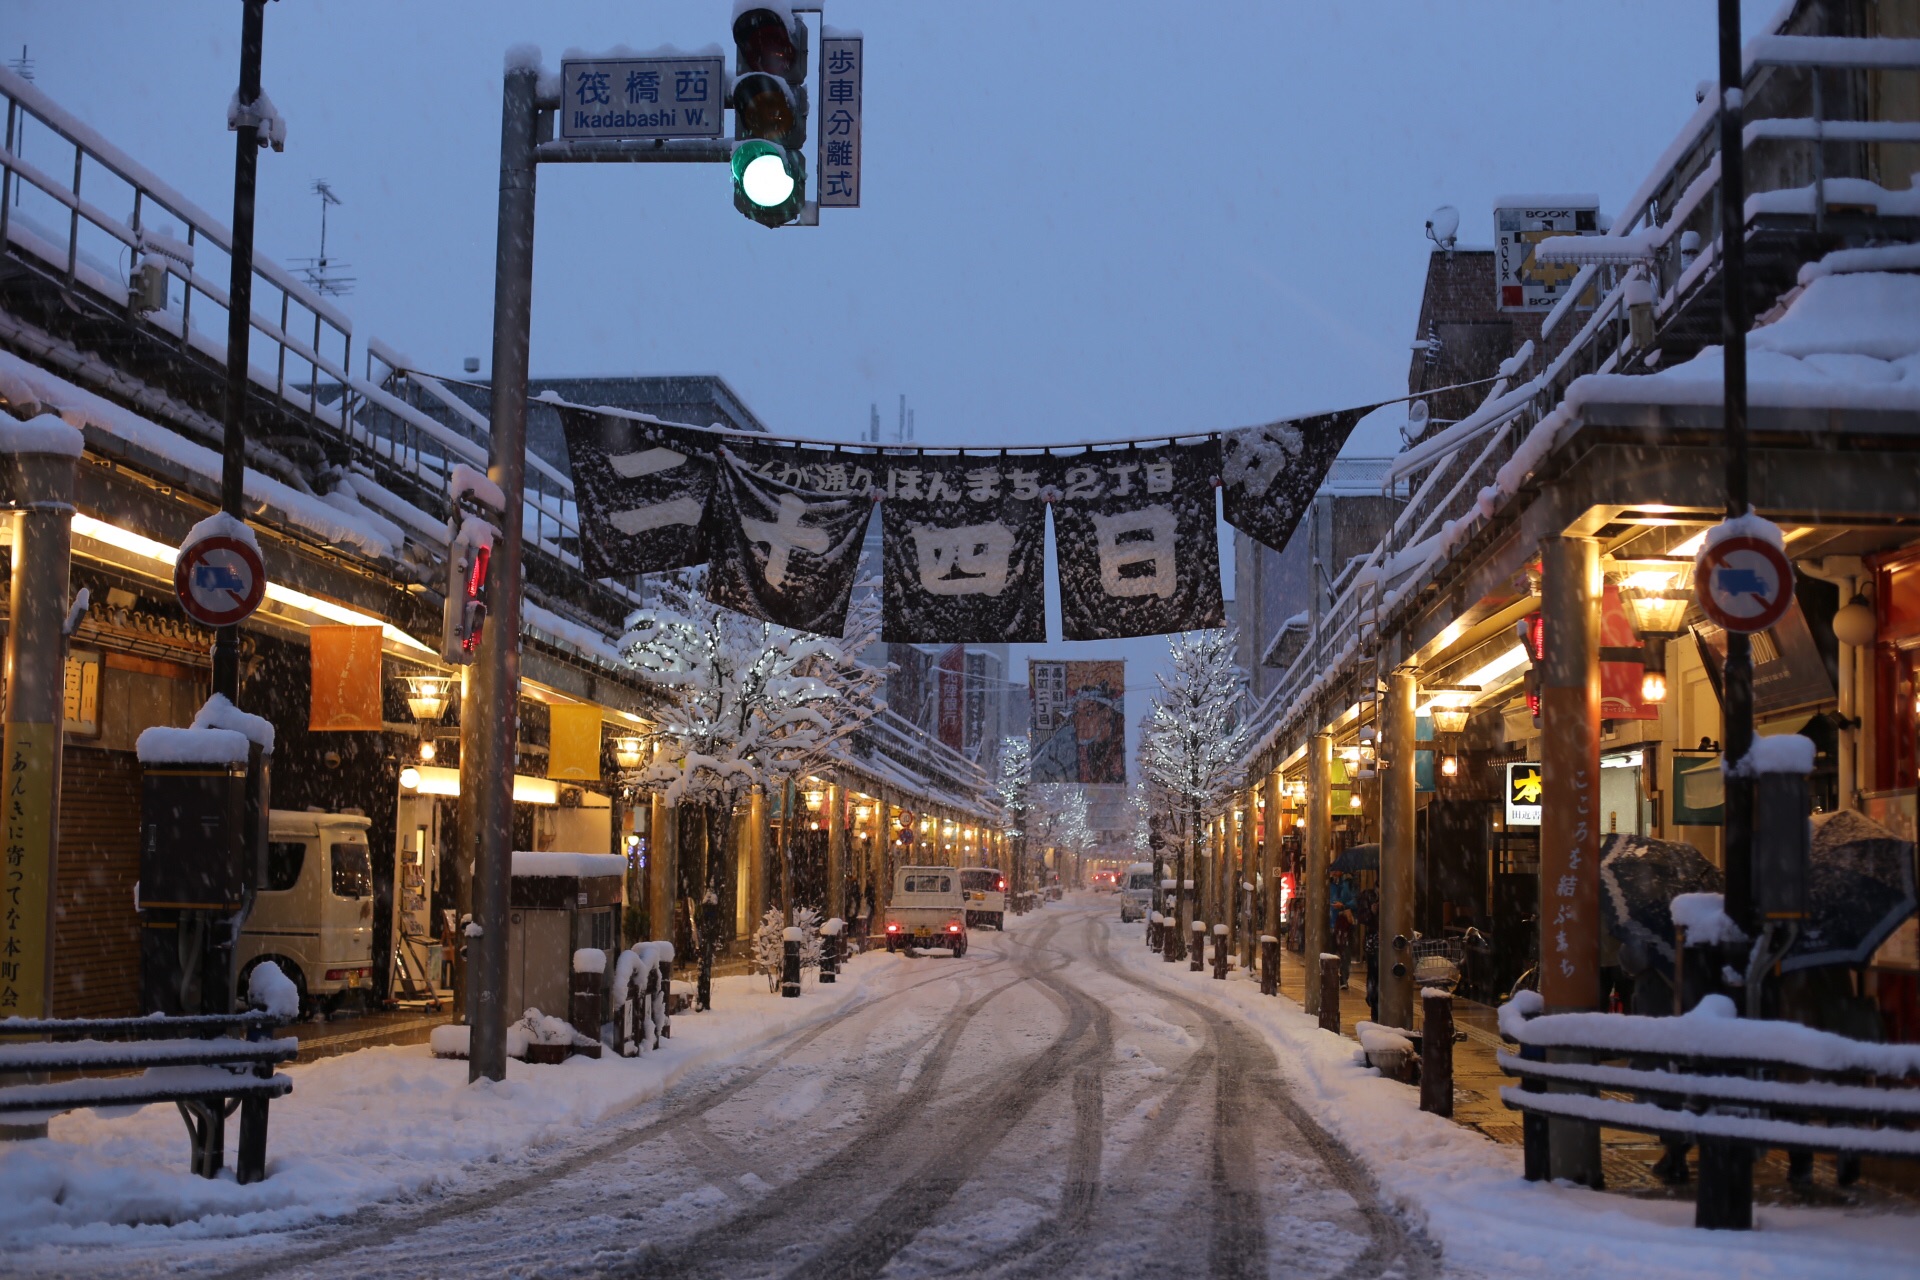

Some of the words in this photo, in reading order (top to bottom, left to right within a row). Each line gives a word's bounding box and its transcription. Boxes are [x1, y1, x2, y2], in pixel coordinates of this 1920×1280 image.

[575, 70, 710, 105] 筏橋西
[574, 108, 676, 129] Ikadabashi
[685, 108, 709, 128] W.
[826, 48, 856, 198] 歩車分離式
[1525, 210, 1571, 219] BOOK
[1501, 237, 1509, 281] BOOK
[1529, 297, 1561, 306] BOO
[1512, 768, 1543, 803] 本
[1512, 809, 1541, 820] 田近書
[1553, 770, 1589, 979] こころを結ぶまち
